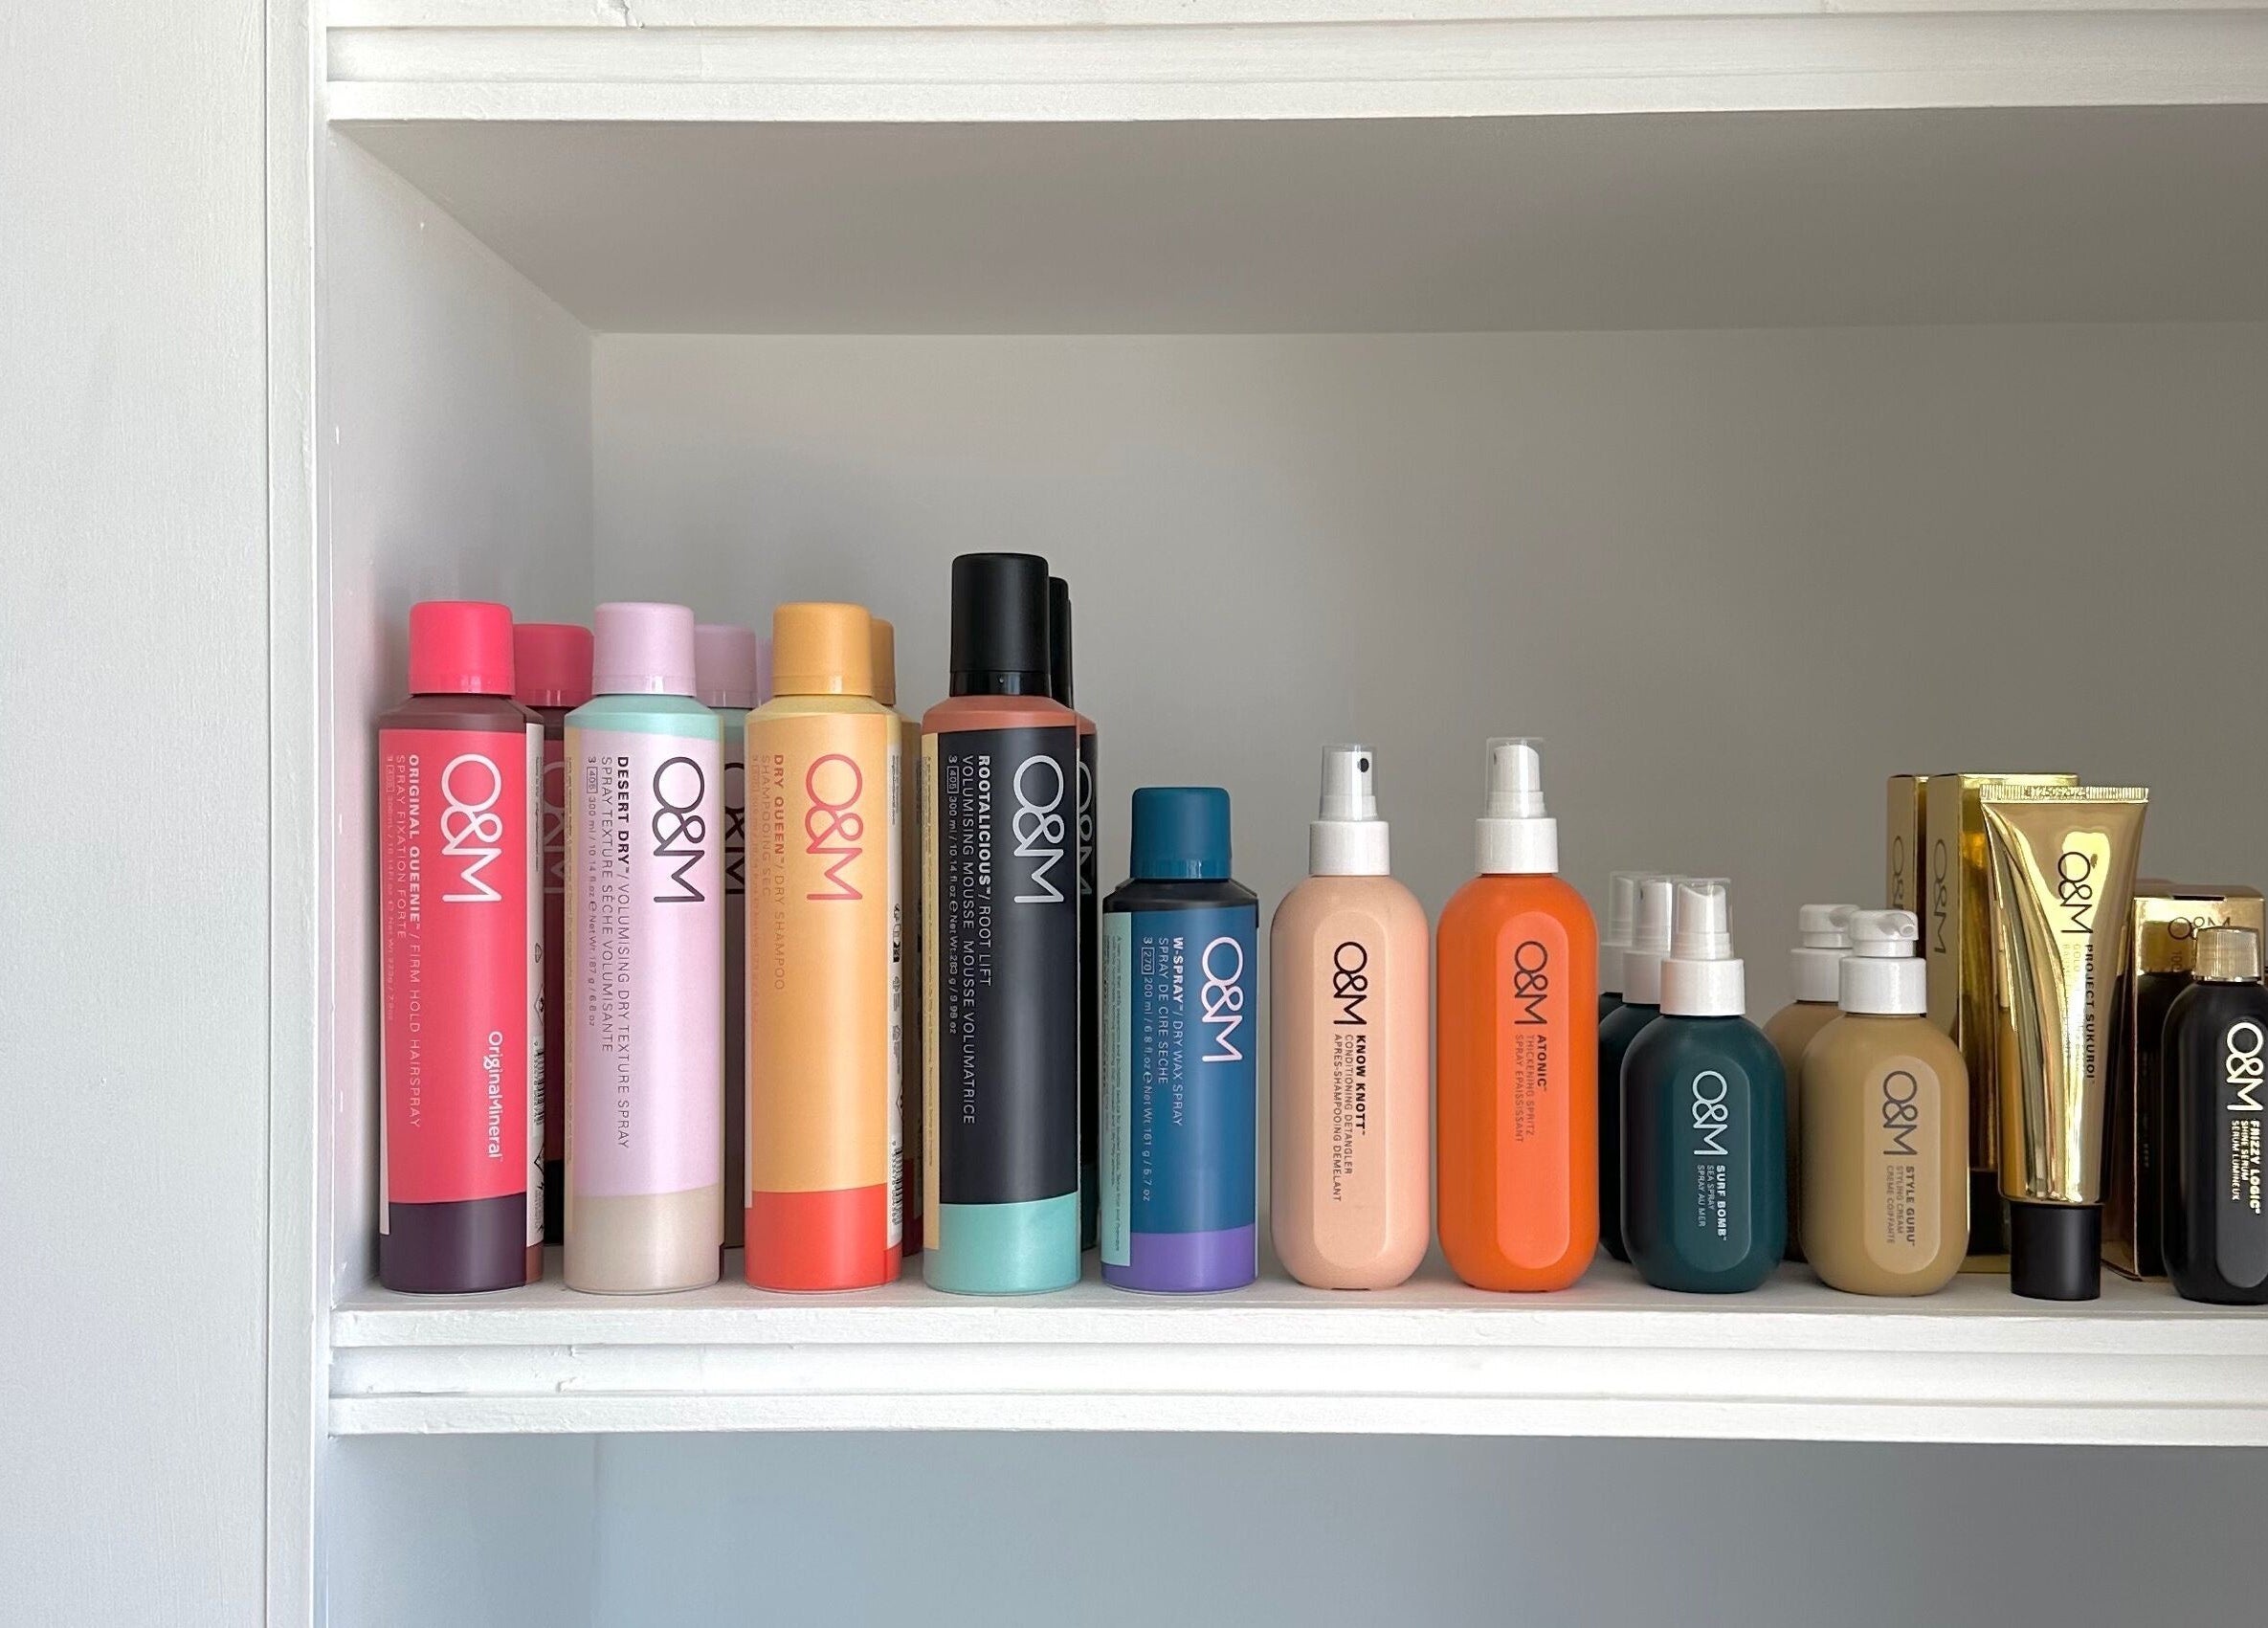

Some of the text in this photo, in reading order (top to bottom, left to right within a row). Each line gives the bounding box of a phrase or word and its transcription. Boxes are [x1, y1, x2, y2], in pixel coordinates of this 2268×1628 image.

[601, 756, 612, 805] SPRAY
[774, 754, 784, 788] DRY
[948, 755, 957, 764] 3
[409, 754, 420, 839] ORIGINAL
[588, 796, 596, 816] 300
[617, 756, 629, 823] DESERT
[948, 796, 957, 816] 300
[396, 755, 407, 938] SPRAY FIXATION FORTE
[441, 754, 502, 902] O&M
[588, 819, 596, 834] ml
[602, 811, 612, 878] TEXTURE
[652, 756, 706, 903] O&M
[762, 755, 771, 897] SHAMPOOING SEC
[805, 753, 864, 901] O&M
[948, 819, 957, 833] ml
[1012, 755, 1065, 903] O&M
[774, 875, 785, 905] DRY
[1892, 836, 1904, 911] O&
[1933, 838, 1947, 954] O&M
[2057, 852, 2094, 934] O&M
[589, 915, 597, 933] Net
[617, 883, 630, 983] VOLUMISING
[962, 755, 975, 1125] VOLUMISING MOUSSE MOUSSE VOLUMATRICE
[978, 906, 991, 948] ROOT
[410, 945, 420, 983] FIRM
[774, 911, 786, 991] SHAMPOO
[979, 954, 991, 987] LIFT
[1144, 950, 1153, 971] 270
[1158, 937, 1168, 979] SPRAY
[602, 941, 613, 1053] VOLUMISANTE
[1144, 977, 1153, 997] 200
[1158, 984, 1168, 1001] DE
[1201, 936, 1244, 1062] O&M
[1333, 942, 1368, 1025] O&M
[1514, 941, 1548, 1025] O&M
[2084, 944, 2095, 1008] PROJECT
[410, 990, 420, 1033] HOLD
[617, 990, 630, 1020] DRY
[949, 1022, 957, 1034] oz
[1144, 1001, 1153, 1015] ml
[1158, 1007, 1168, 1037] CIRE
[1172, 1020, 1184, 1047] DRY
[1356, 1035, 1367, 1077] KNOW
[410, 1039, 421, 1127] HAIRSPRAY
[617, 1025, 630, 1094] TEXTURE
[1172, 1051, 1184, 1081] WAX
[2225, 1022, 2264, 1111] O&M
[1143, 1085, 1152, 1105] Net
[1172, 1084, 1184, 1126] SPRAY
[1344, 1034, 1354, 1174] CONDITIONING DETANGLER
[1515, 1035, 1524, 1143] SPRAY EPAISSISSANT
[1525, 1035, 1535, 1136] THICKENING SPRITZ
[617, 1100, 630, 1149] SPRAY
[1143, 1128, 1152, 1146] 161
[1692, 1070, 1728, 1155] O&M
[1882, 1070, 1919, 1155] O&M
[2232, 1120, 2240, 1201] SERUM LUMINEUX
[2240, 1120, 2249, 1181] SHINE SERUM
[2250, 1120, 2260, 1165] FRIZZY
[1143, 1189, 1150, 1202] oz
[1697, 1165, 1706, 1228] SPRAY AU MER
[1706, 1165, 1716, 1211] SEA SPRAY
[1716, 1165, 1726, 1196] SURF
[1895, 1165, 1904, 1234] STYLING CREAM
[1905, 1166, 1915, 1204] STYLE
